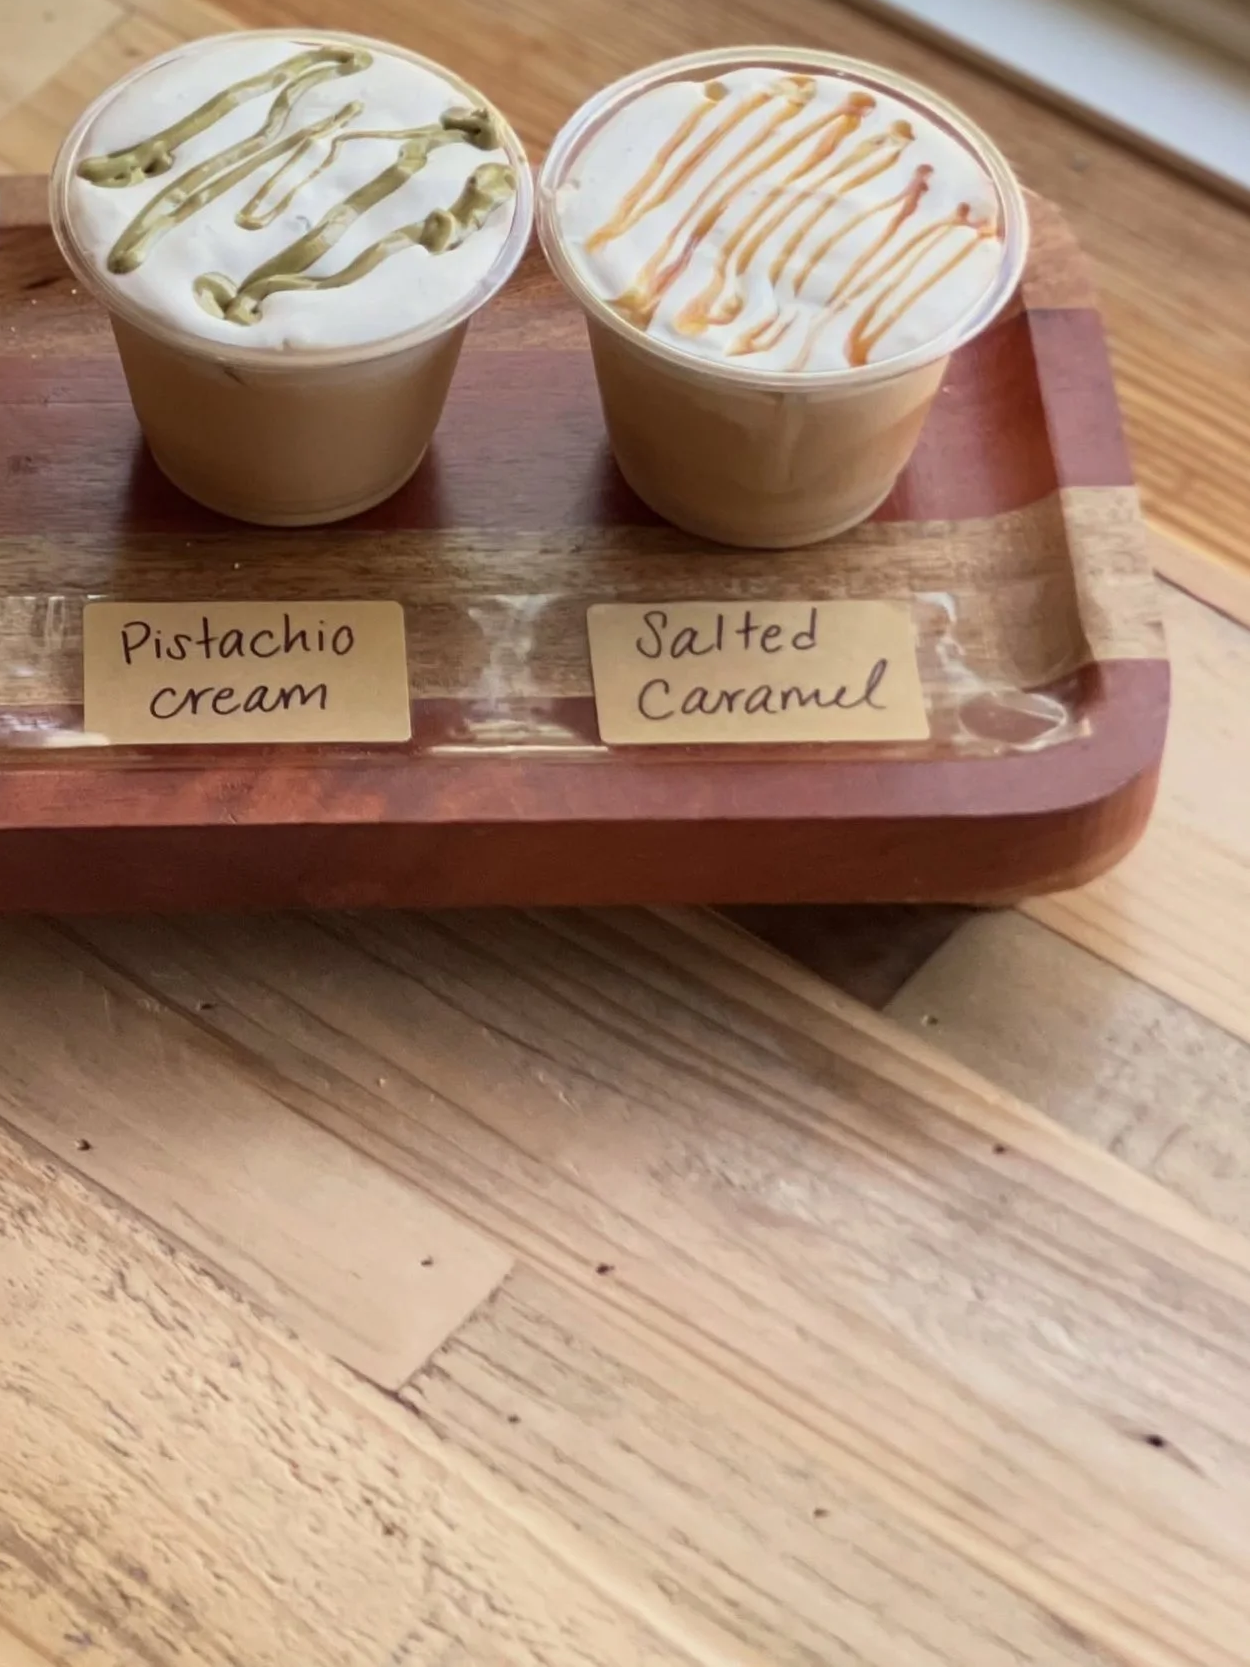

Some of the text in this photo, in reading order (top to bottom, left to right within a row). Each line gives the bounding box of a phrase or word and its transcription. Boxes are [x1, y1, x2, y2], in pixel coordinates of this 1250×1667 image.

[120, 613, 355, 665] Pistachio
[636, 607, 819, 659] Salted
[638, 658, 888, 720] Caramel
